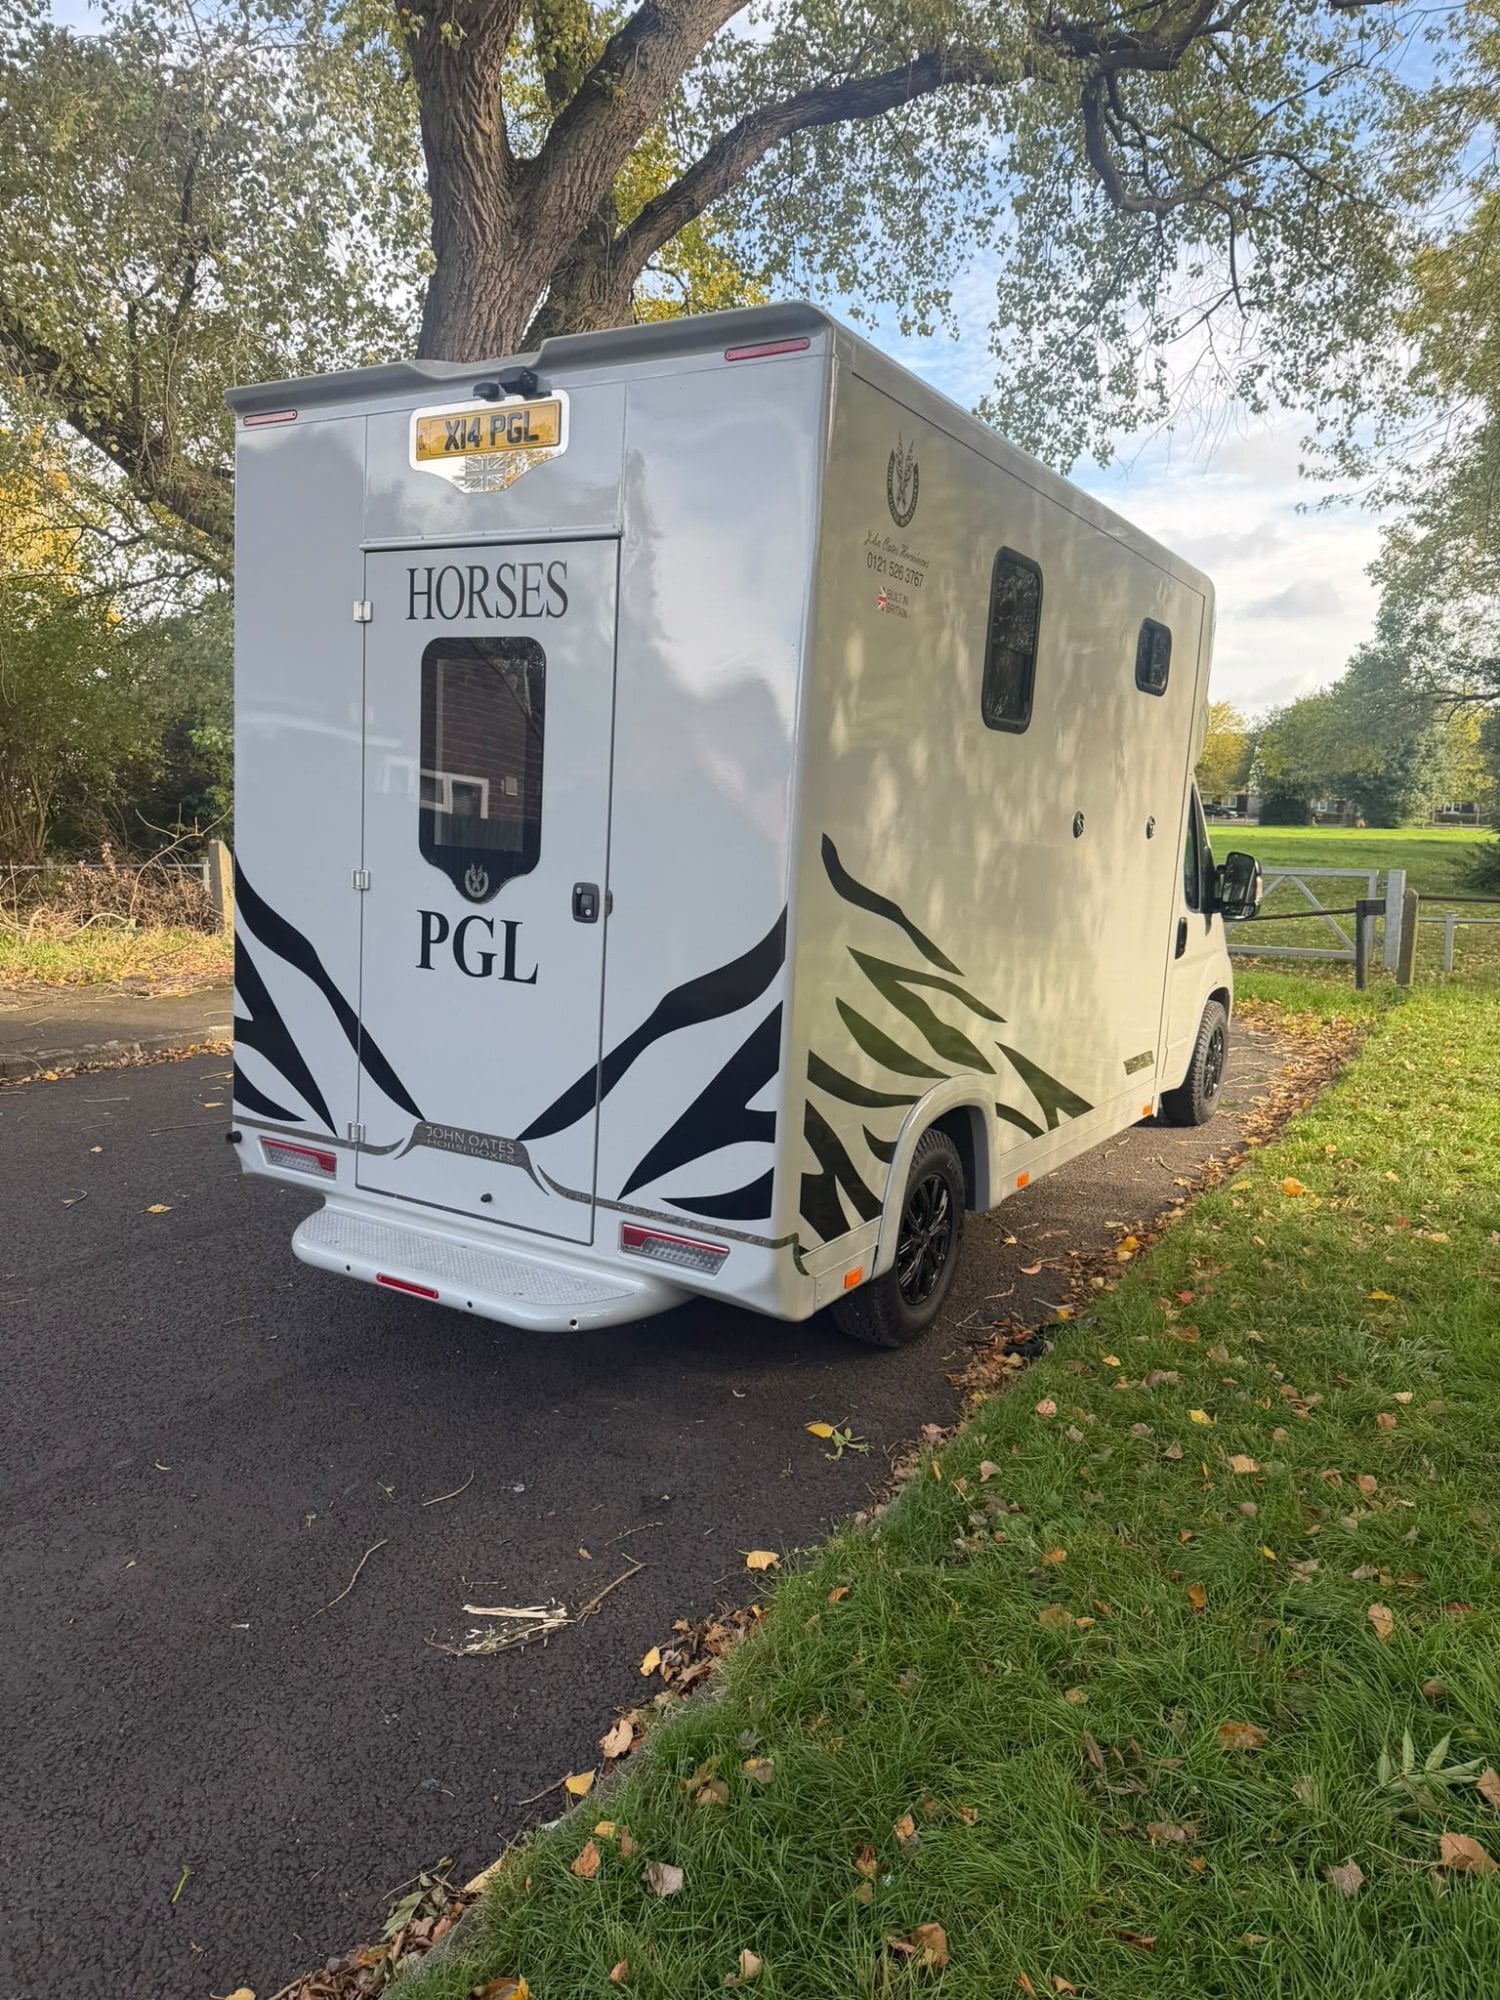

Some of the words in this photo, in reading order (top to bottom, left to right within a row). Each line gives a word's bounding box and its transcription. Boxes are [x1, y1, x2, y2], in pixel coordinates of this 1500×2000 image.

[444, 416, 482, 451] X14
[489, 410, 540, 447] PGL
[405, 560, 569, 621] HORSES
[867, 552, 887, 574] 0121
[889, 561, 904, 581] 526
[904, 567, 924, 589] 3767
[415, 909, 539, 985] PGL
[425, 1125, 465, 1144] JOHN
[468, 1134, 516, 1155] OATES
